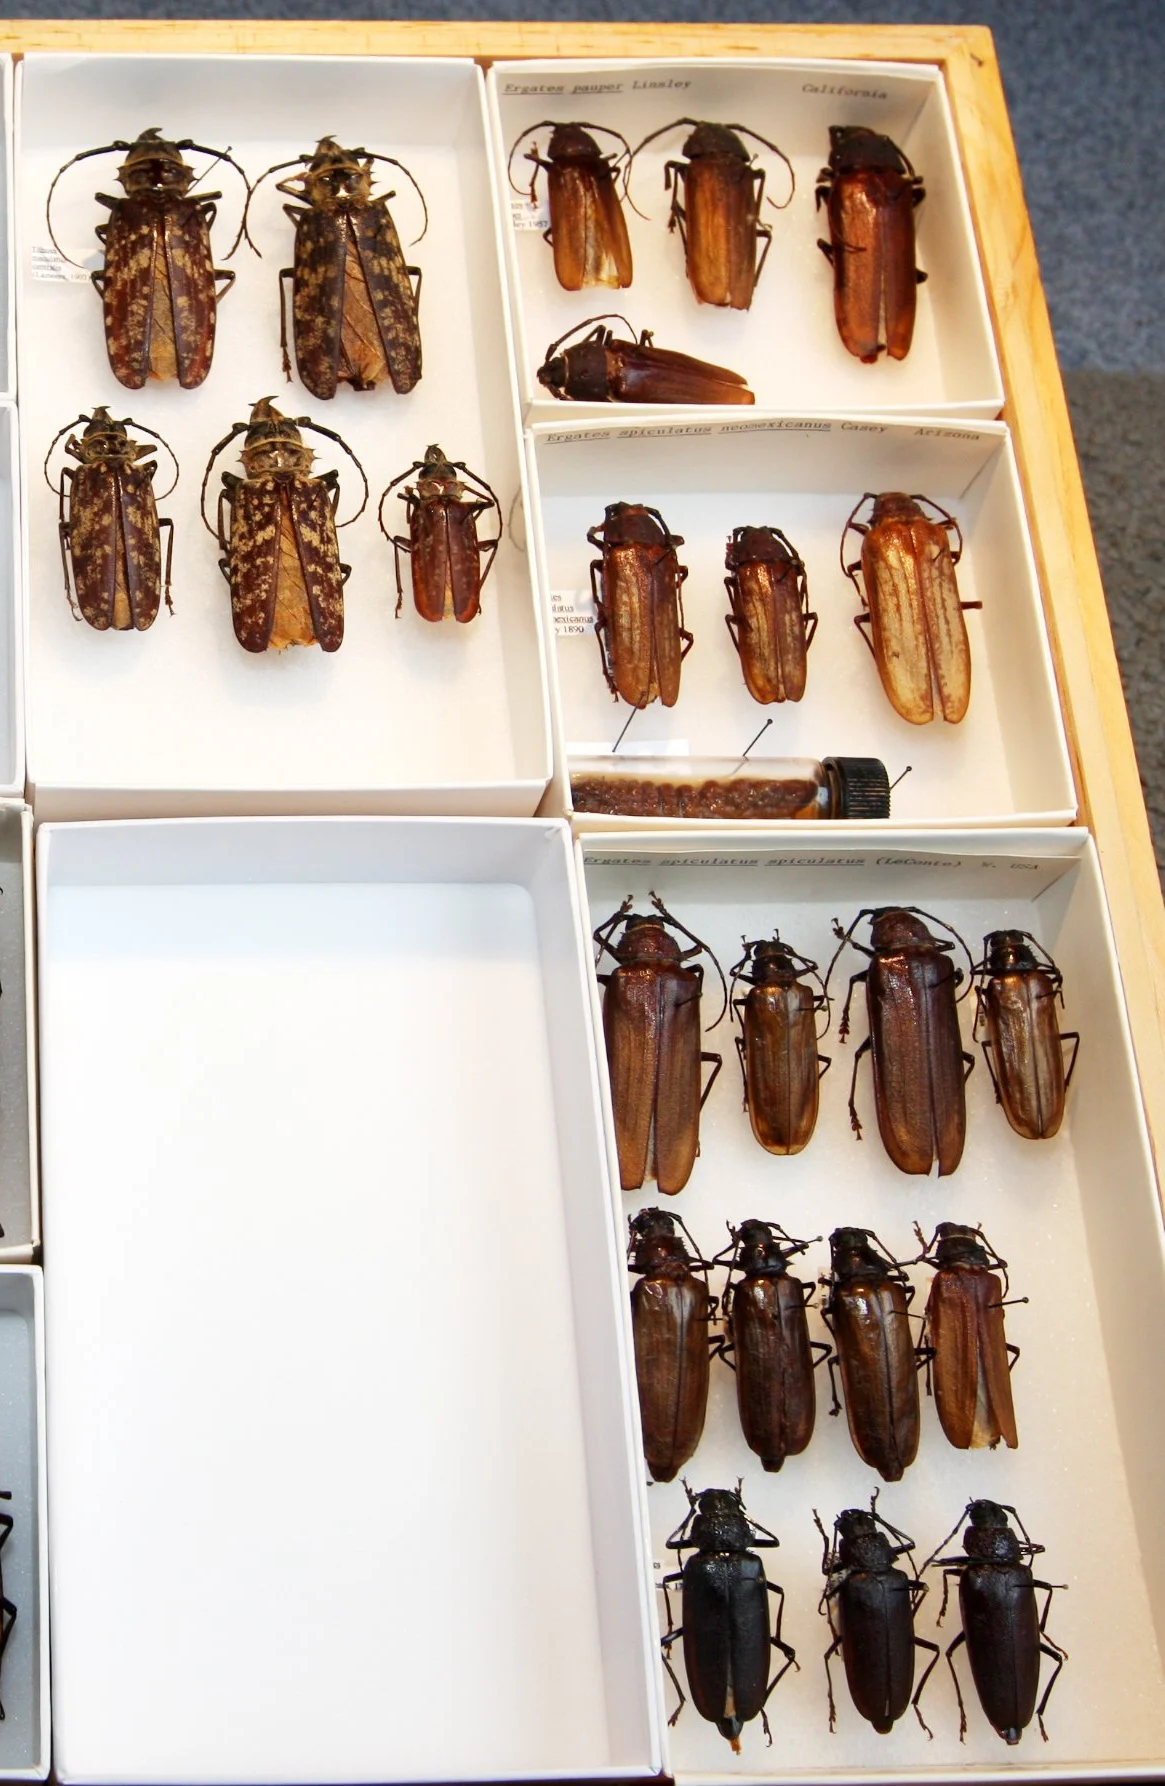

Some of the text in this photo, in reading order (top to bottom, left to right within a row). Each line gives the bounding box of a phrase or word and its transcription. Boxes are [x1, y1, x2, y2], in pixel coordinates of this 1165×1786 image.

[502, 79, 692, 95] Ergates pauper Linsley
[801, 83, 889, 100] California
[544, 420, 888, 444] Ergates spiculatus neomexicanus Casey
[914, 428, 981, 441] Arizona
[583, 856, 652, 867] Ergates
[659, 856, 758, 867] spiculatus
[764, 856, 865, 867] spiculatus
